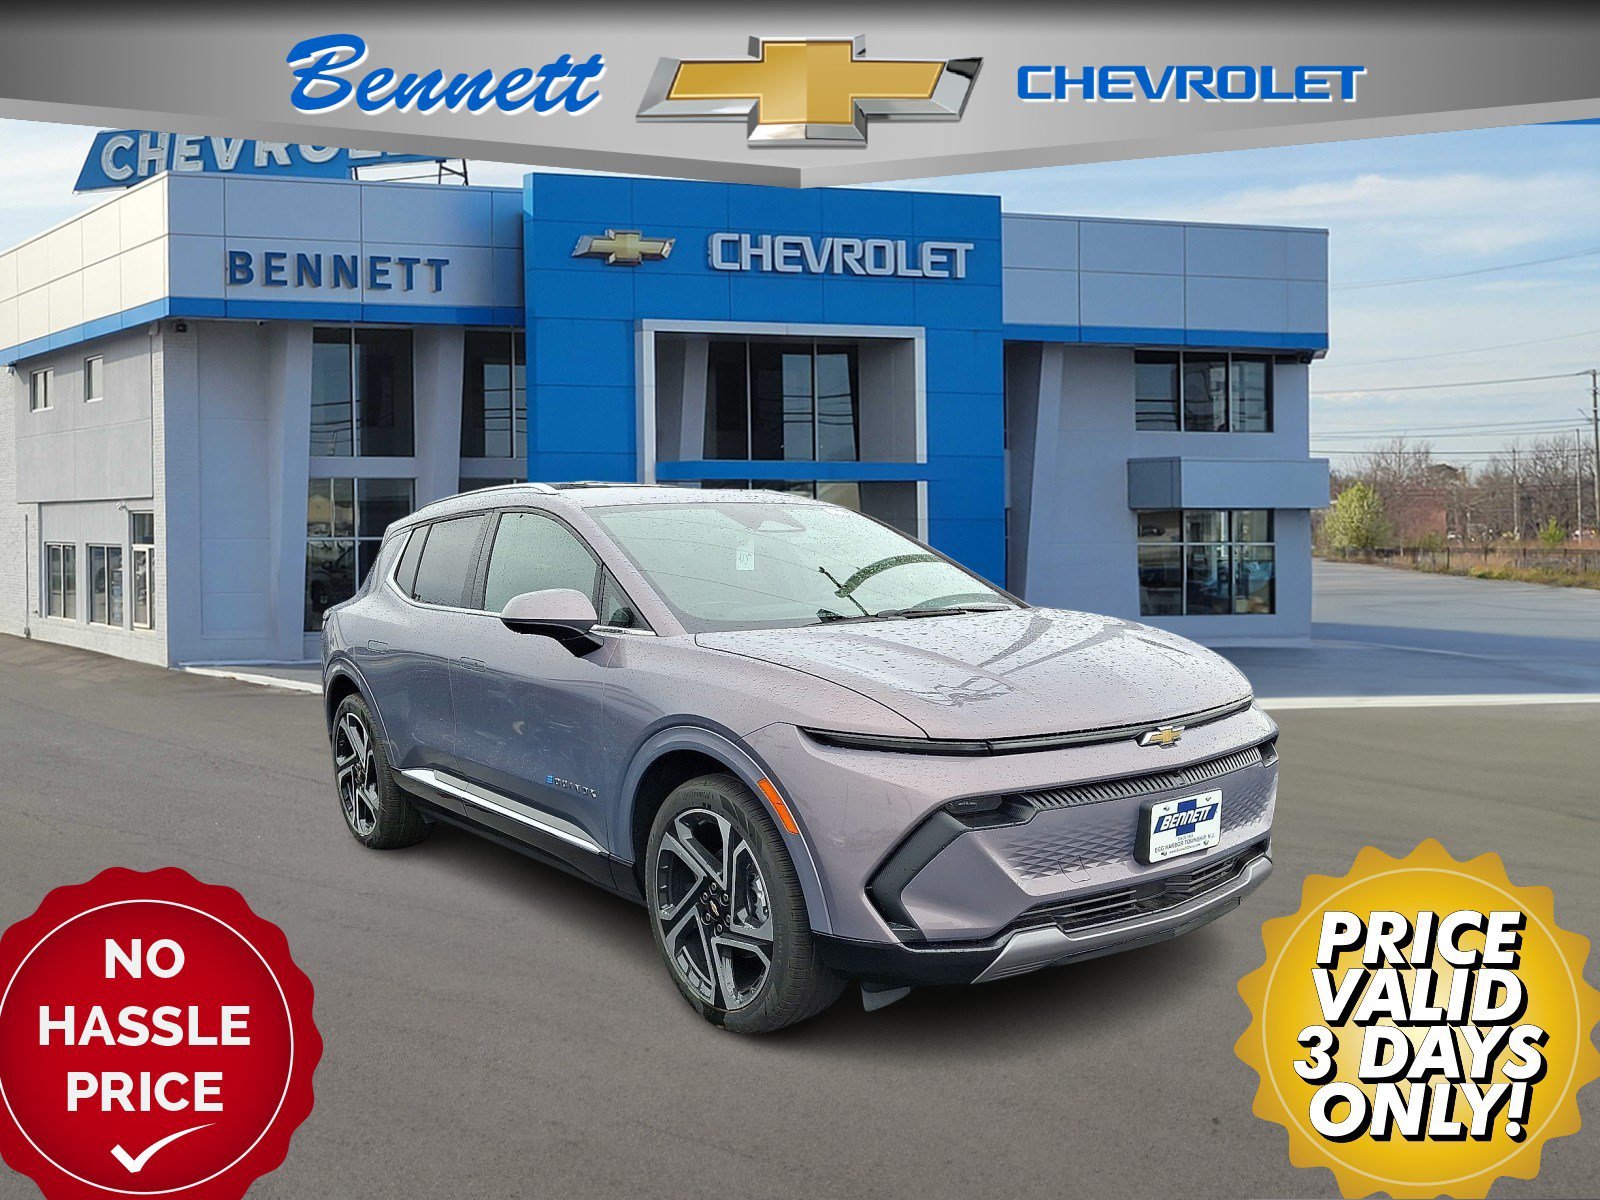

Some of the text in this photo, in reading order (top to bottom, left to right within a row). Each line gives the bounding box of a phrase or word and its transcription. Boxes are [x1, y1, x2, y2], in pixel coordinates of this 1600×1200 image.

[226, 250, 449, 293] BENNETT
[708, 232, 974, 278] CHEVROLET
[1160, 806, 1212, 831] BENNETT
